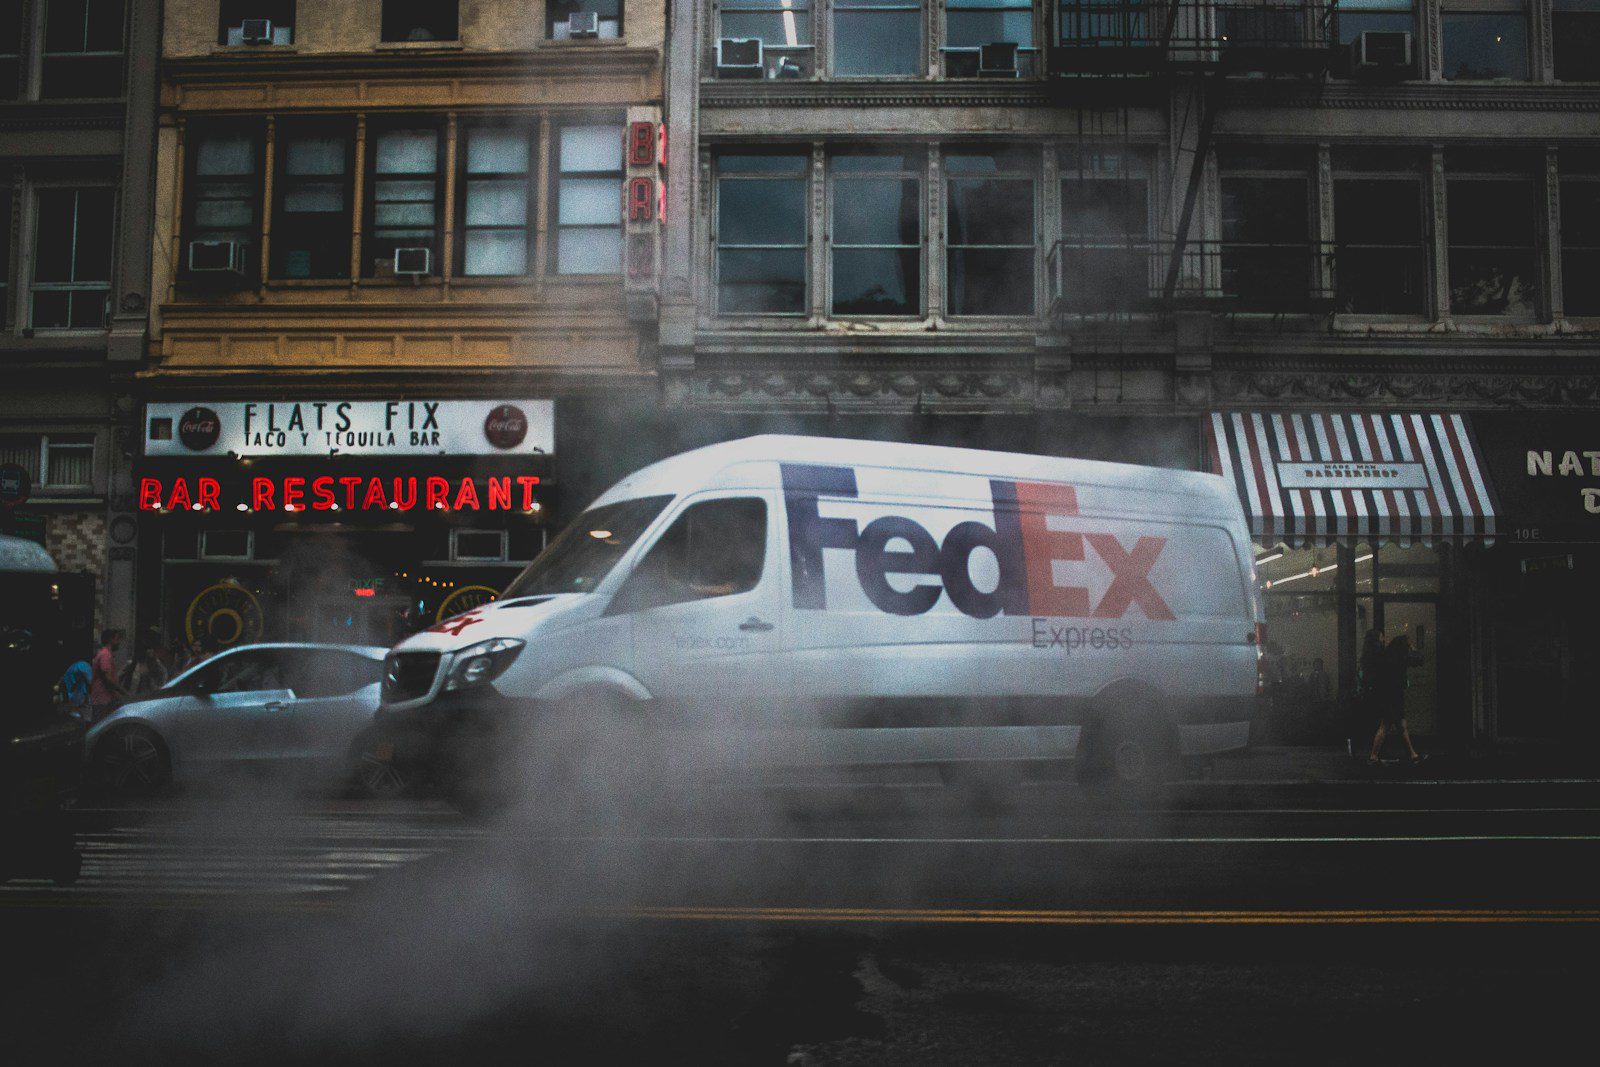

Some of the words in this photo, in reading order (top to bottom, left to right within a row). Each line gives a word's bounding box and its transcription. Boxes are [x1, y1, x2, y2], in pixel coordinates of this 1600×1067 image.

[244, 403, 353, 432] FLATS
[386, 402, 440, 430] FIX
[244, 431, 286, 447] TACO
[301, 431, 309, 447] Y
[325, 431, 396, 447] TEQUILA
[410, 430, 440, 447] BAR
[1304, 470, 1399, 478] BARBERSHOP
[1526, 450, 1600, 477] NAT
[139, 476, 221, 511] BAR
[252, 475, 541, 512] RESTAURANT
[779, 462, 1177, 621] FedEx
[1031, 617, 1133, 656] Express
